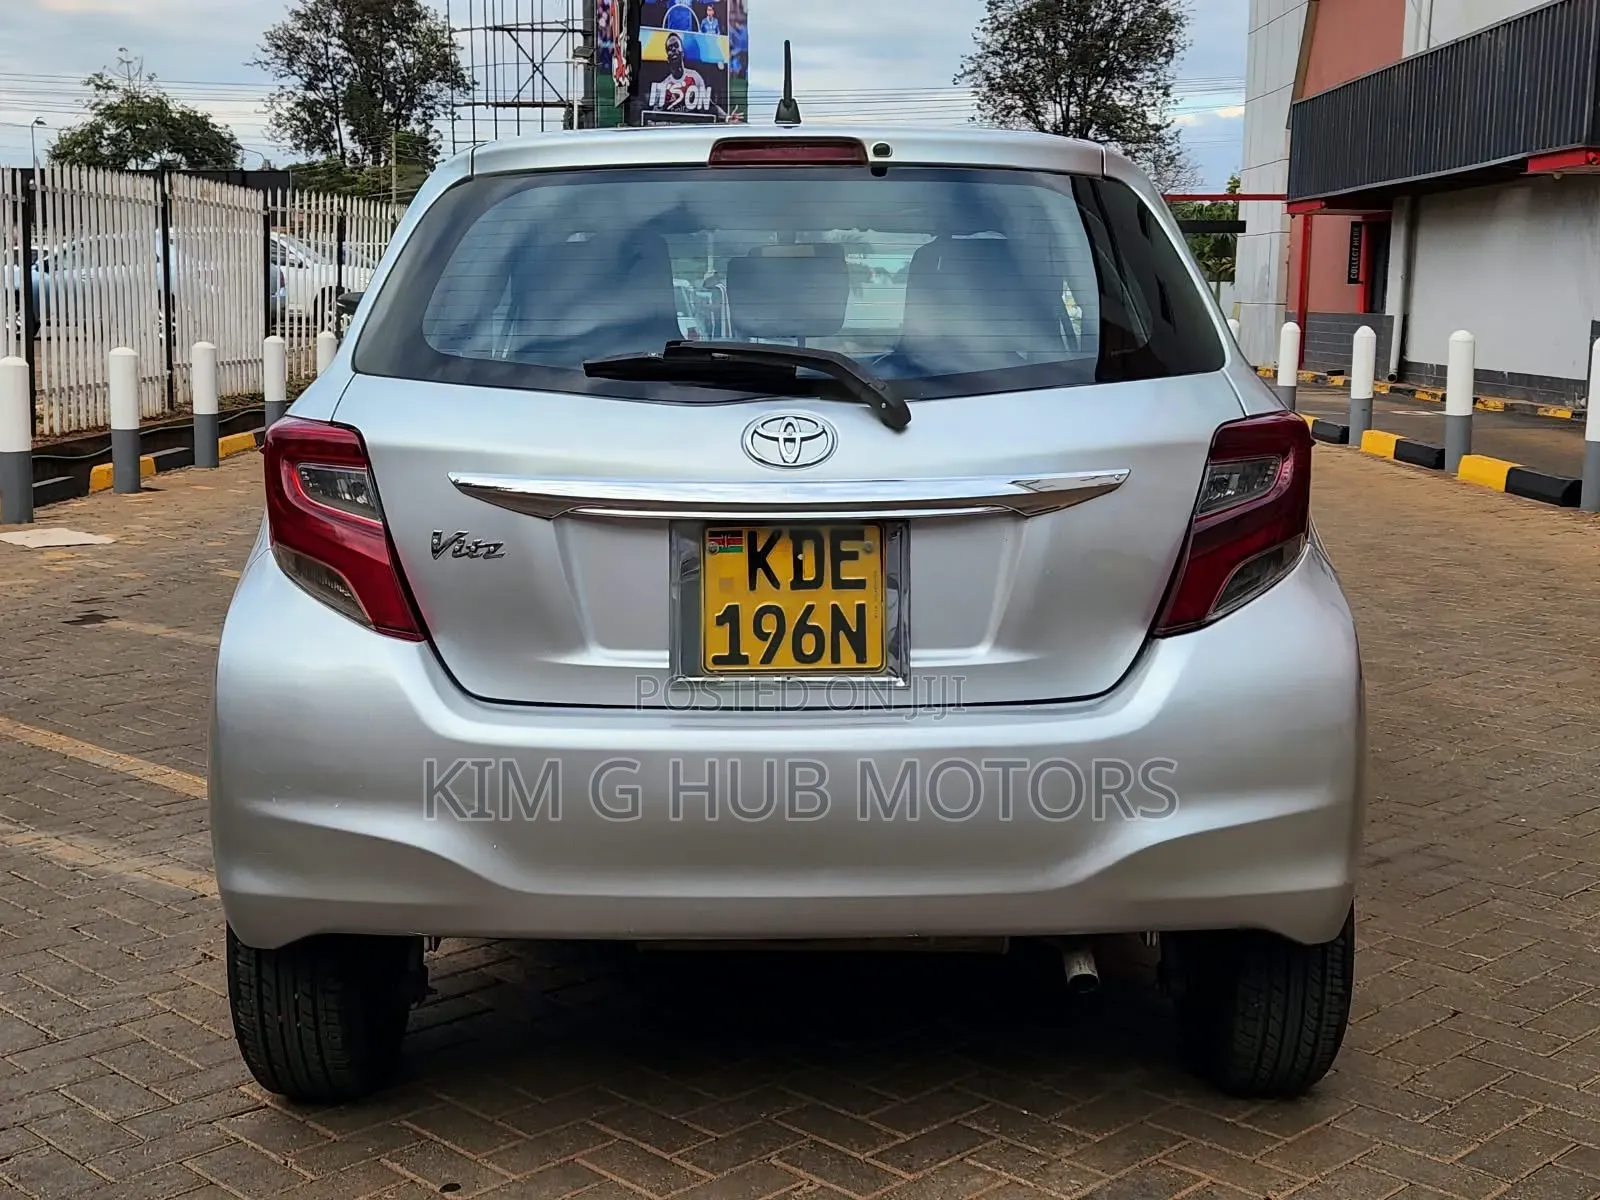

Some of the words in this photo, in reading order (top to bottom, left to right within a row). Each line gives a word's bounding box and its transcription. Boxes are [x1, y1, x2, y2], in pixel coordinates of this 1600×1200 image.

[685, 85, 712, 110] ON
[1350, 247, 1359, 279] COLLECT
[431, 529, 505, 560] Vitz
[747, 529, 867, 591] KDE
[711, 602, 868, 665] 196N
